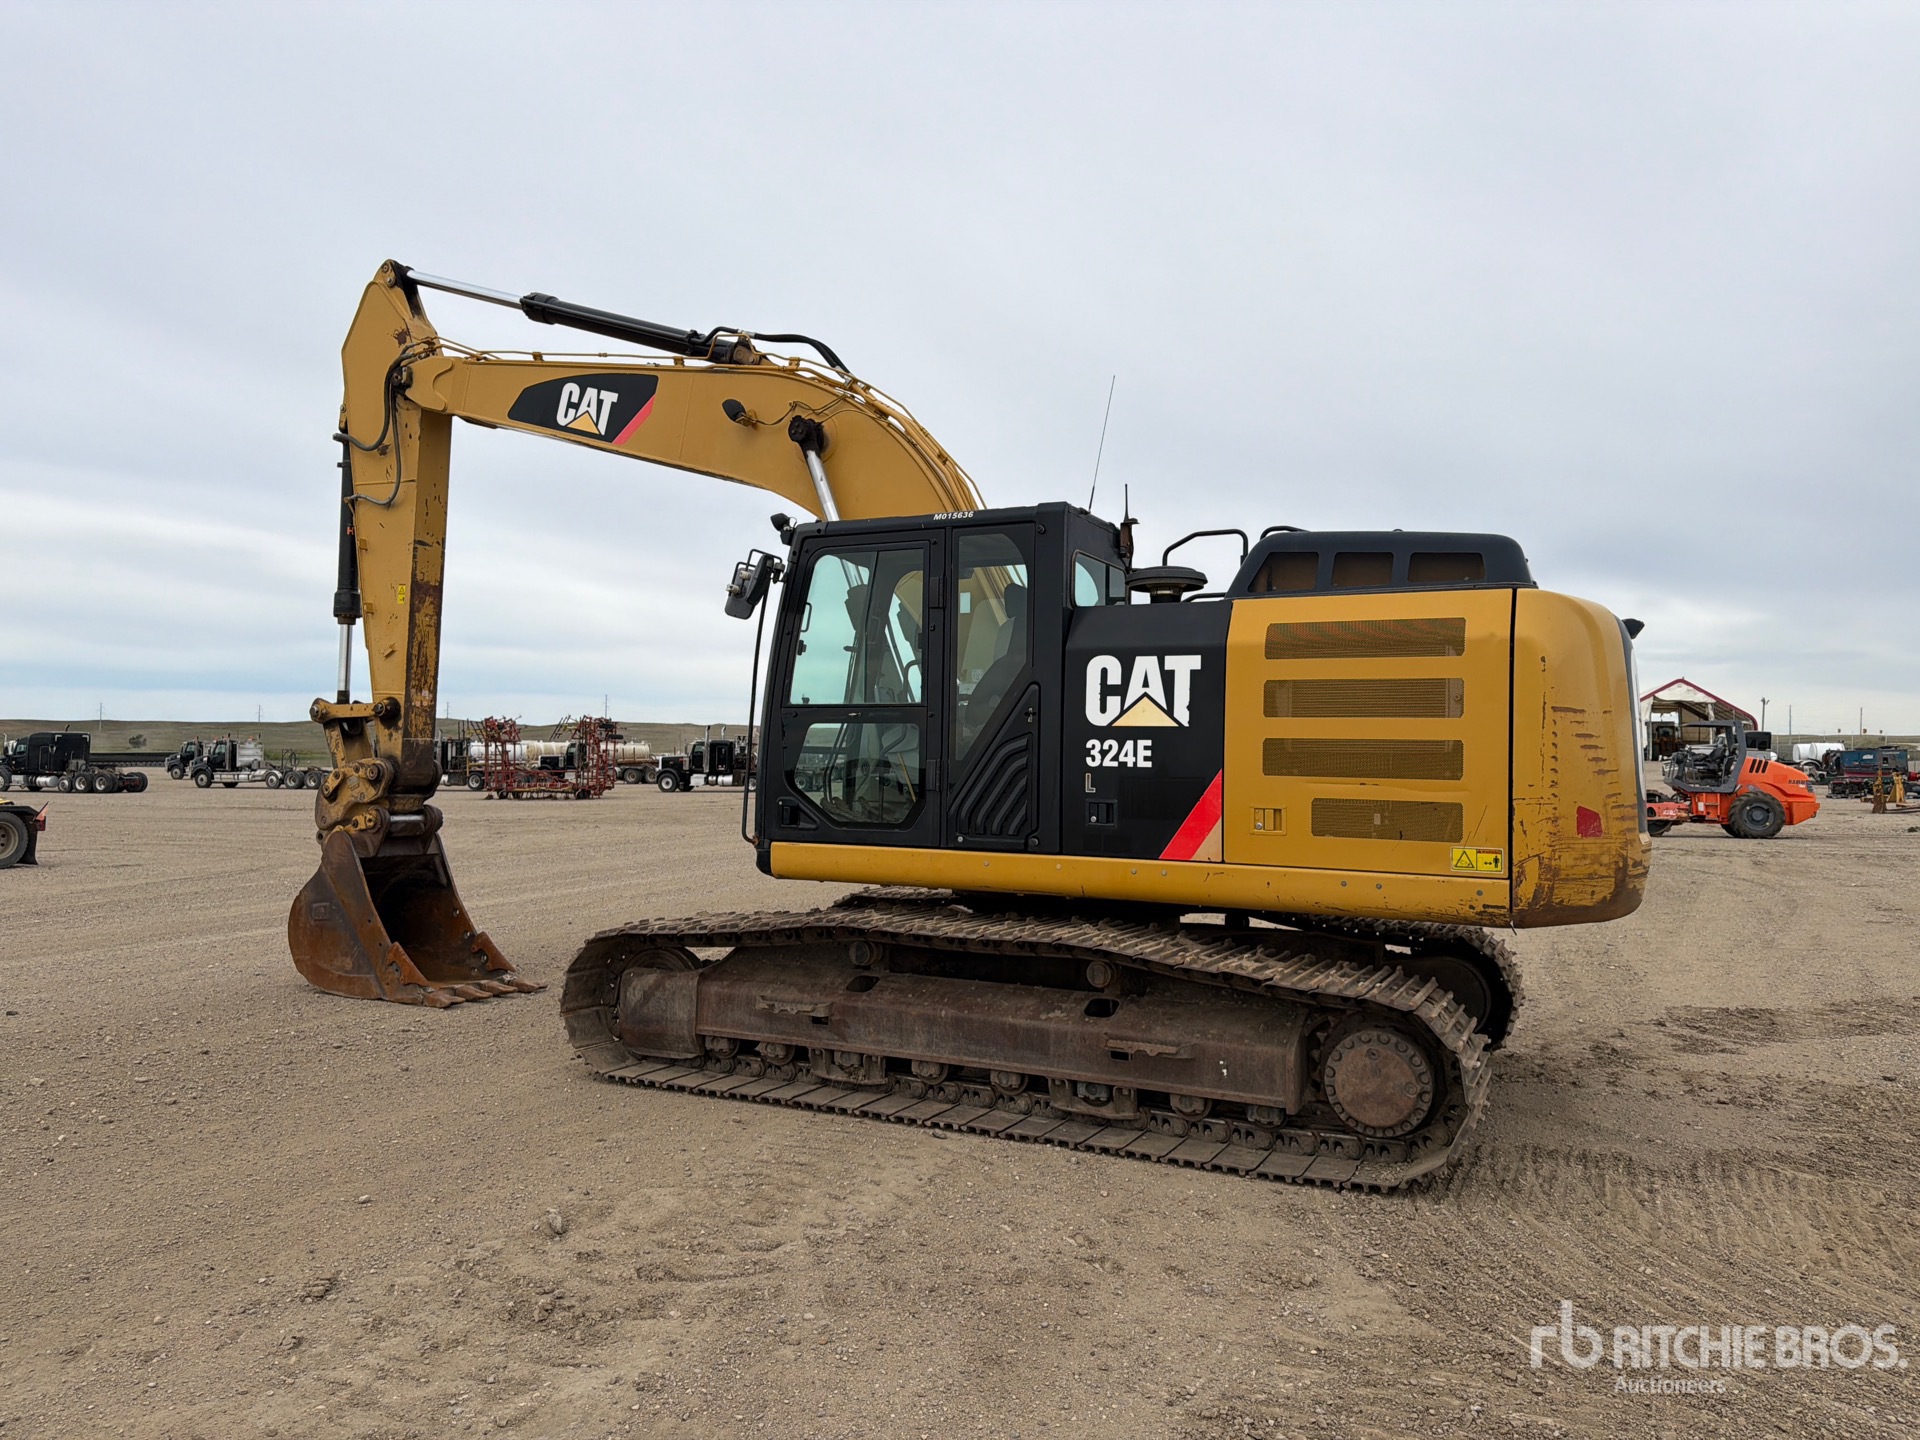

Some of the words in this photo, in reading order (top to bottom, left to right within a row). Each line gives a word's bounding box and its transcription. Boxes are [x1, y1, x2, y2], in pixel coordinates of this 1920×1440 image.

[556, 382, 619, 436] CAT
[933, 511, 974, 521] M015636
[1085, 655, 1202, 727] CAT
[1085, 739, 1153, 767] 324E
[1085, 773, 1096, 793] L
